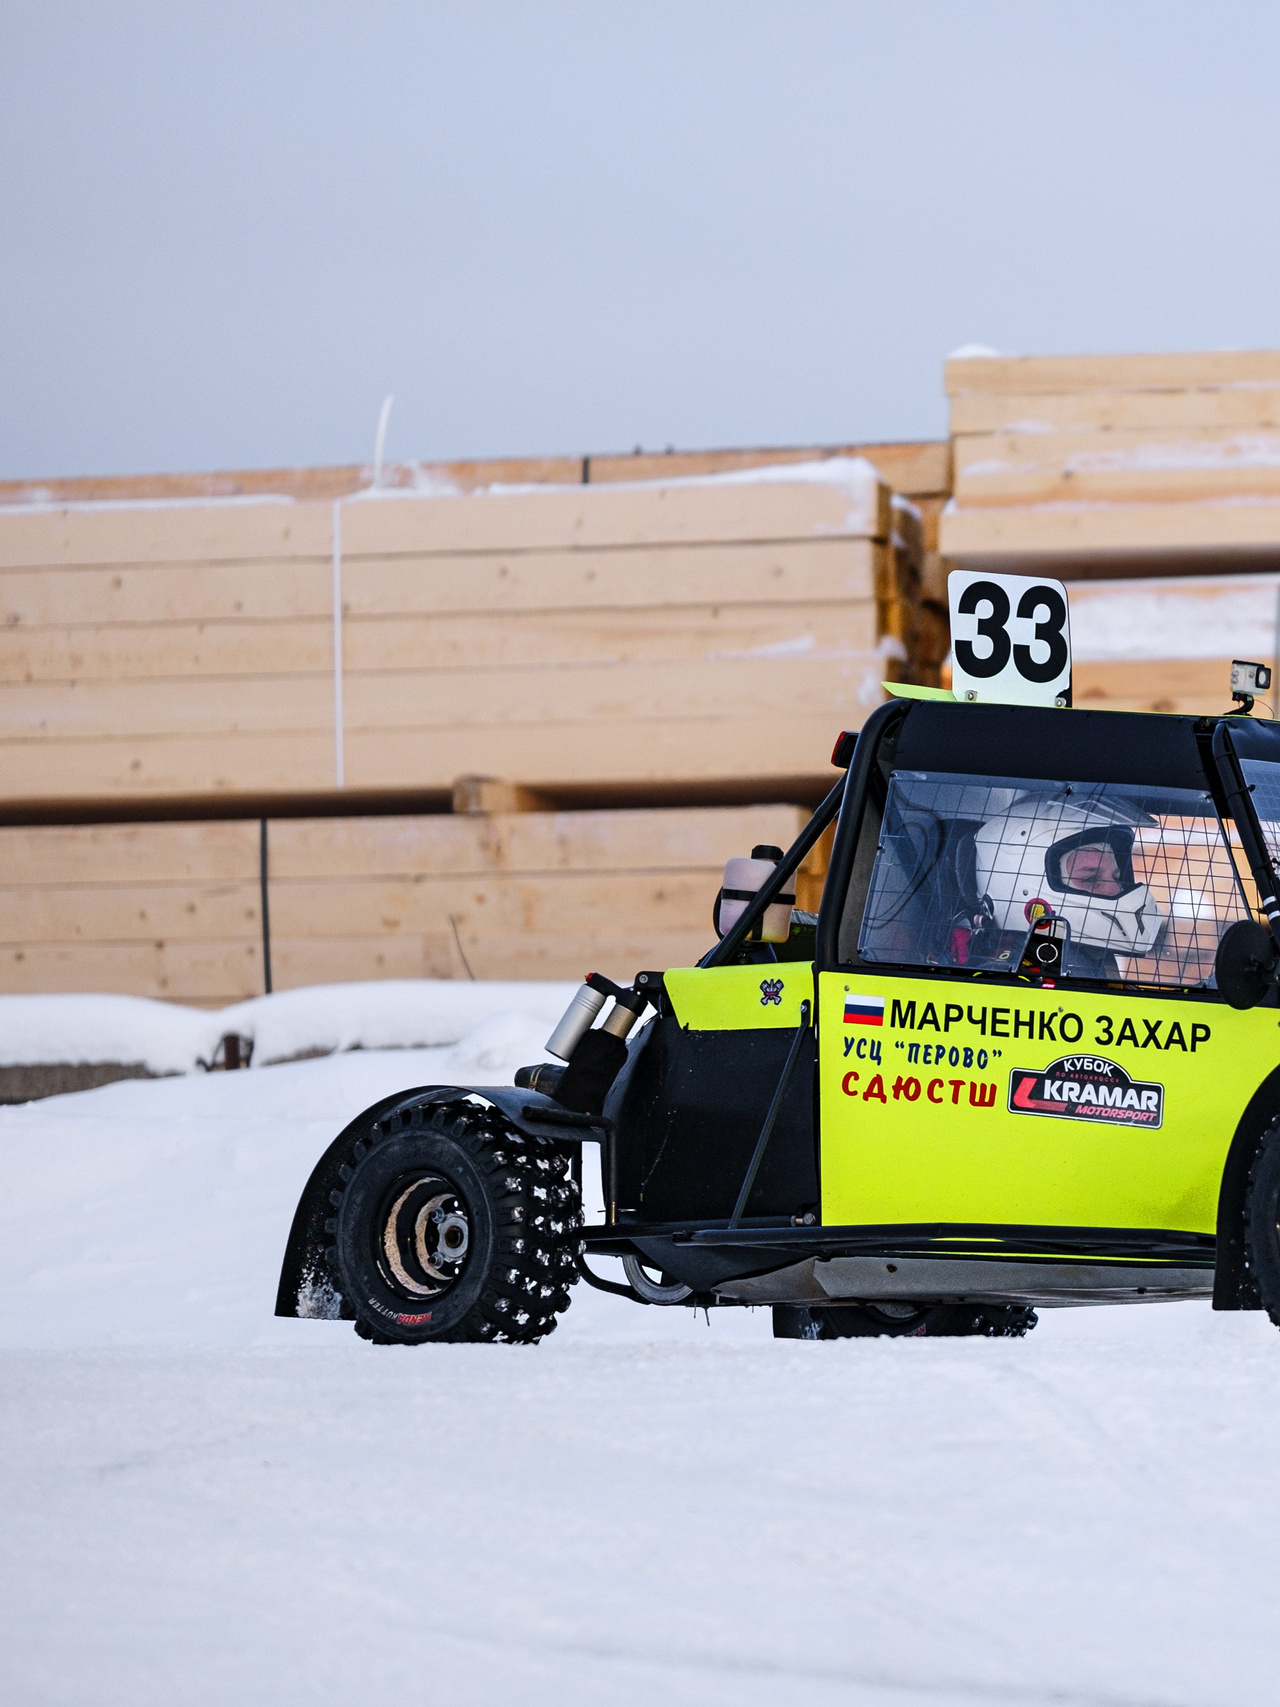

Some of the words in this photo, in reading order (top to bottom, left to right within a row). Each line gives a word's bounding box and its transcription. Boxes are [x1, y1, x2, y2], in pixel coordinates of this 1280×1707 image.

[955, 580, 1068, 683] 33
[889, 999, 1083, 1043] МАРЧЕНКО
[1094, 1015, 1212, 1052] ЗАХАР
[842, 1036, 882, 1066] УСЦ
[1063, 1058, 1115, 1078] КУБОК
[841, 1071, 997, 1108] СДЮСТШ
[1043, 1079, 1159, 1112] KRAMAR
[1075, 1104, 1158, 1122] MOTORSPORT
